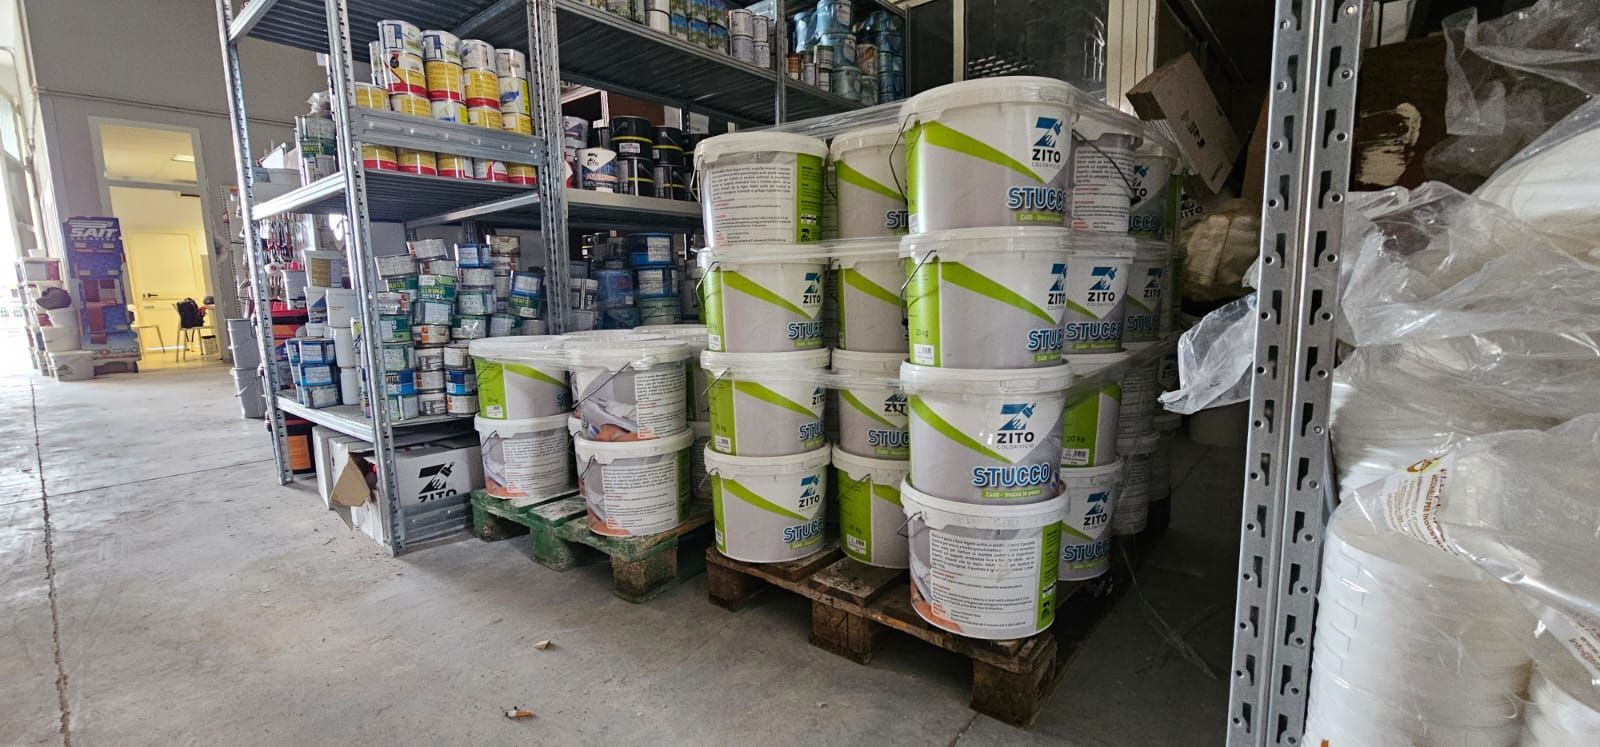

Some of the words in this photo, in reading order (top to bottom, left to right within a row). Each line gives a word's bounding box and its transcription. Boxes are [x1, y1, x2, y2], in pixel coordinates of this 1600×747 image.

[1032, 148, 1061, 163] ZITO
[71, 228, 118, 238] SAIT
[802, 294, 821, 304] ZITO
[1087, 291, 1116, 302] ZITO
[997, 431, 1035, 444] ZITO
[971, 461, 1051, 489] STUCCO
[798, 494, 820, 509] ZITO
[1083, 512, 1108, 526] ZITO
